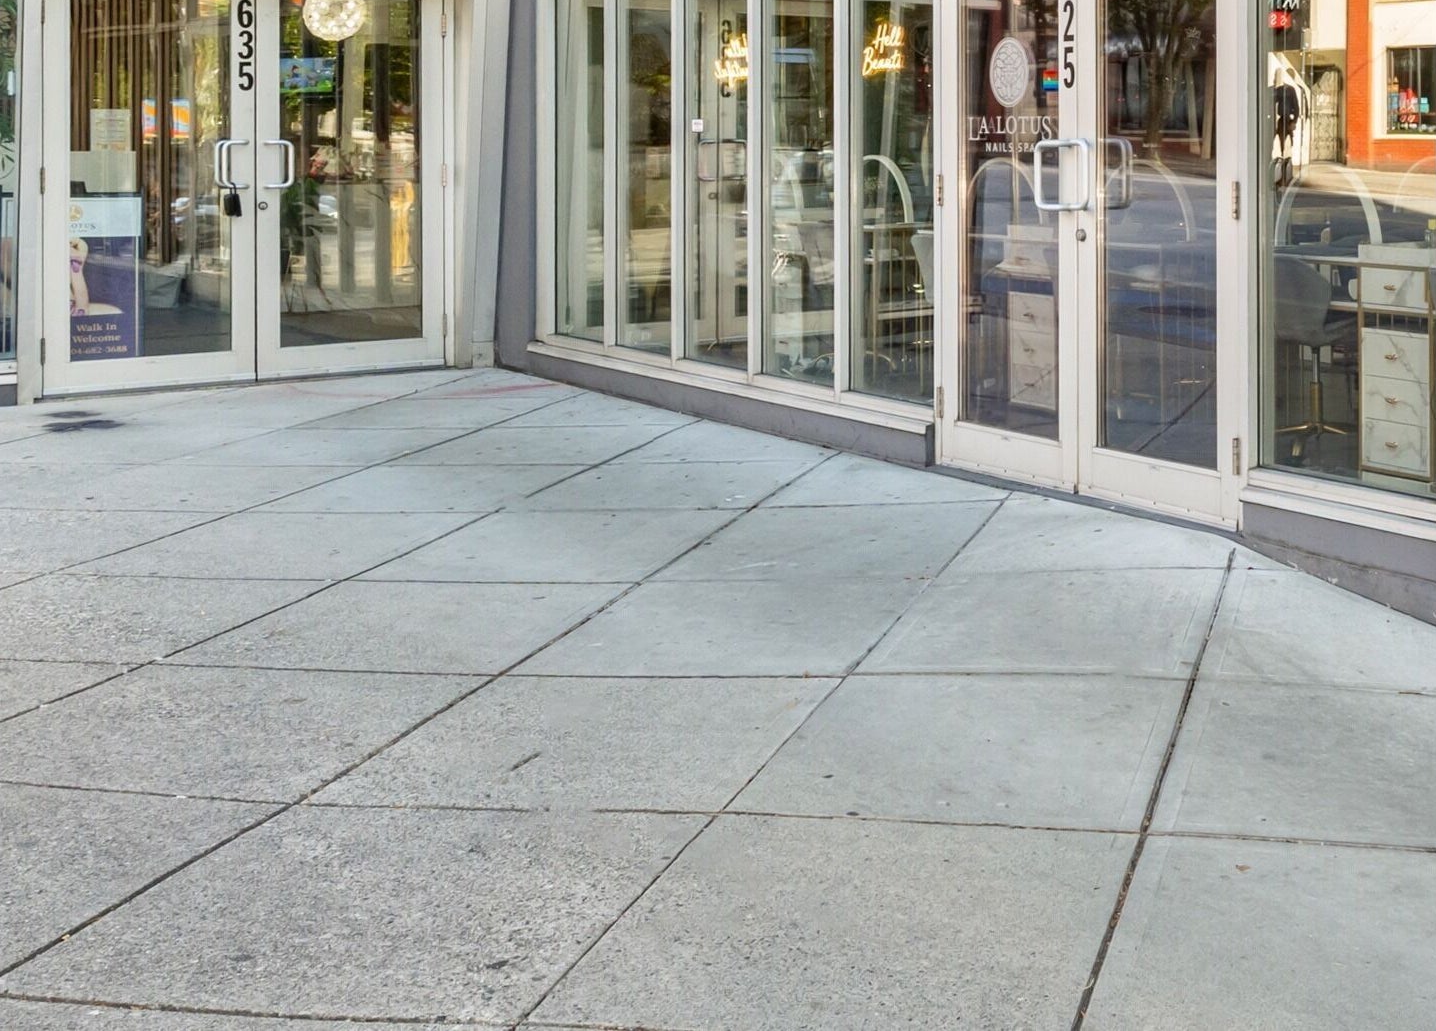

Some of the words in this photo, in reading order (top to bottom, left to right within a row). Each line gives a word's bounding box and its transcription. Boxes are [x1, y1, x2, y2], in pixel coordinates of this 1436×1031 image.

[872, 23, 904, 54] Hell
[968, 116, 990, 141] LA
[996, 115, 1053, 141] LOTUS
[985, 142, 1013, 153] NAILS
[1016, 142, 1035, 153] SPA
[70, 222, 97, 230] OTUS
[76, 323, 103, 332] Walk
[105, 322, 117, 331] In
[72, 334, 122, 343] Welcome
[70, 345, 128, 355] 04-682-3688
